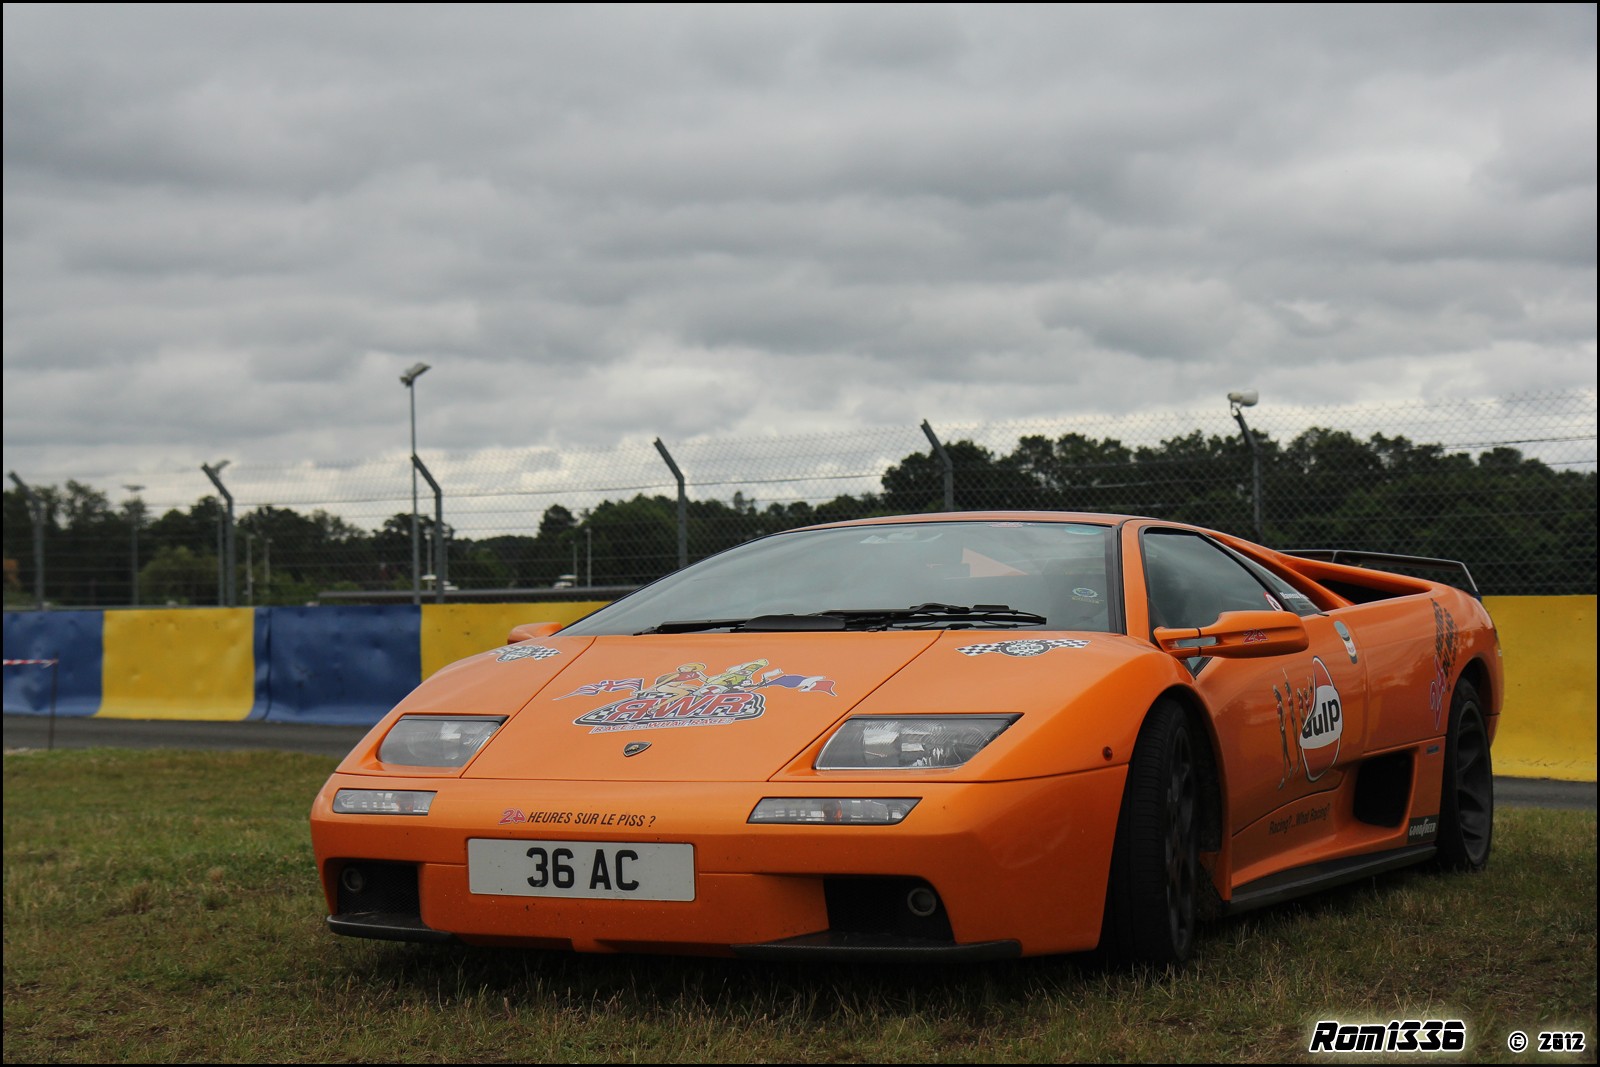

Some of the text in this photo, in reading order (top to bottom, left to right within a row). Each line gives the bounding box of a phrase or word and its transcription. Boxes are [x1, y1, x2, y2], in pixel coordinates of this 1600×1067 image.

[499, 808, 657, 828] 24 HEURES SUR LE PISS ?
[526, 847, 639, 891] 36 AC
